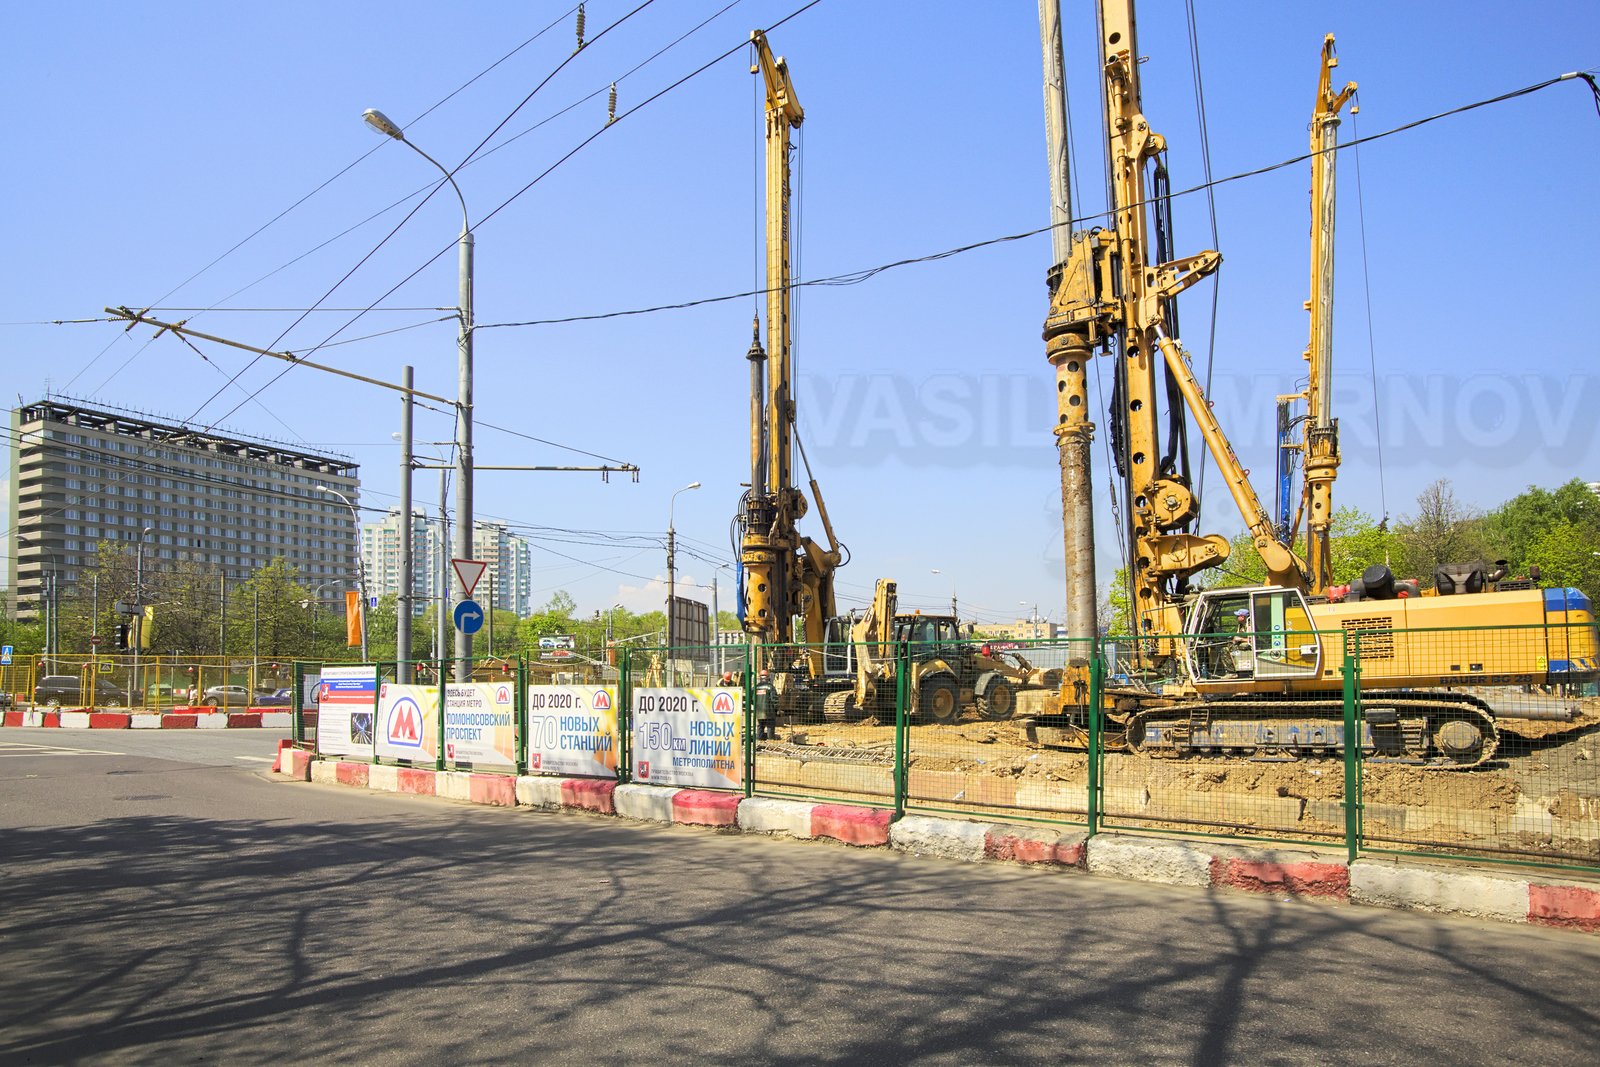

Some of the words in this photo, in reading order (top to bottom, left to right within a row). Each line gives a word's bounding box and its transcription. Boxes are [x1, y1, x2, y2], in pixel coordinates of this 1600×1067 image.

[1440, 675, 1487, 685] BAUER
[1491, 675, 1511, 683] BG
[1514, 674, 1533, 683] 28
[461, 689, 475, 698] БУДЕТ
[447, 700, 466, 708] СТАНЦИЯ
[467, 700, 482, 708] МЕТРО
[532, 694, 546, 711] ДО
[548, 694, 572, 709] 2020
[575, 697, 581, 709] г.
[639, 696, 654, 714] ДО
[659, 696, 687, 713] 2020
[691, 700, 699, 713] г.
[446, 711, 511, 727] ЛОМОНОСОВСКИЙ
[446, 727, 482, 741] ПРОСПЕКТ
[532, 715, 558, 750] 70
[560, 716, 600, 732] НОВЫХ
[639, 721, 672, 751] 150
[689, 721, 735, 738] НОВЫХ
[560, 732, 612, 753] СТАНЦИЙ
[688, 737, 731, 757] ЛИНИЙ
[672, 756, 735, 770] МЕТРОПОЛИТЕНА
